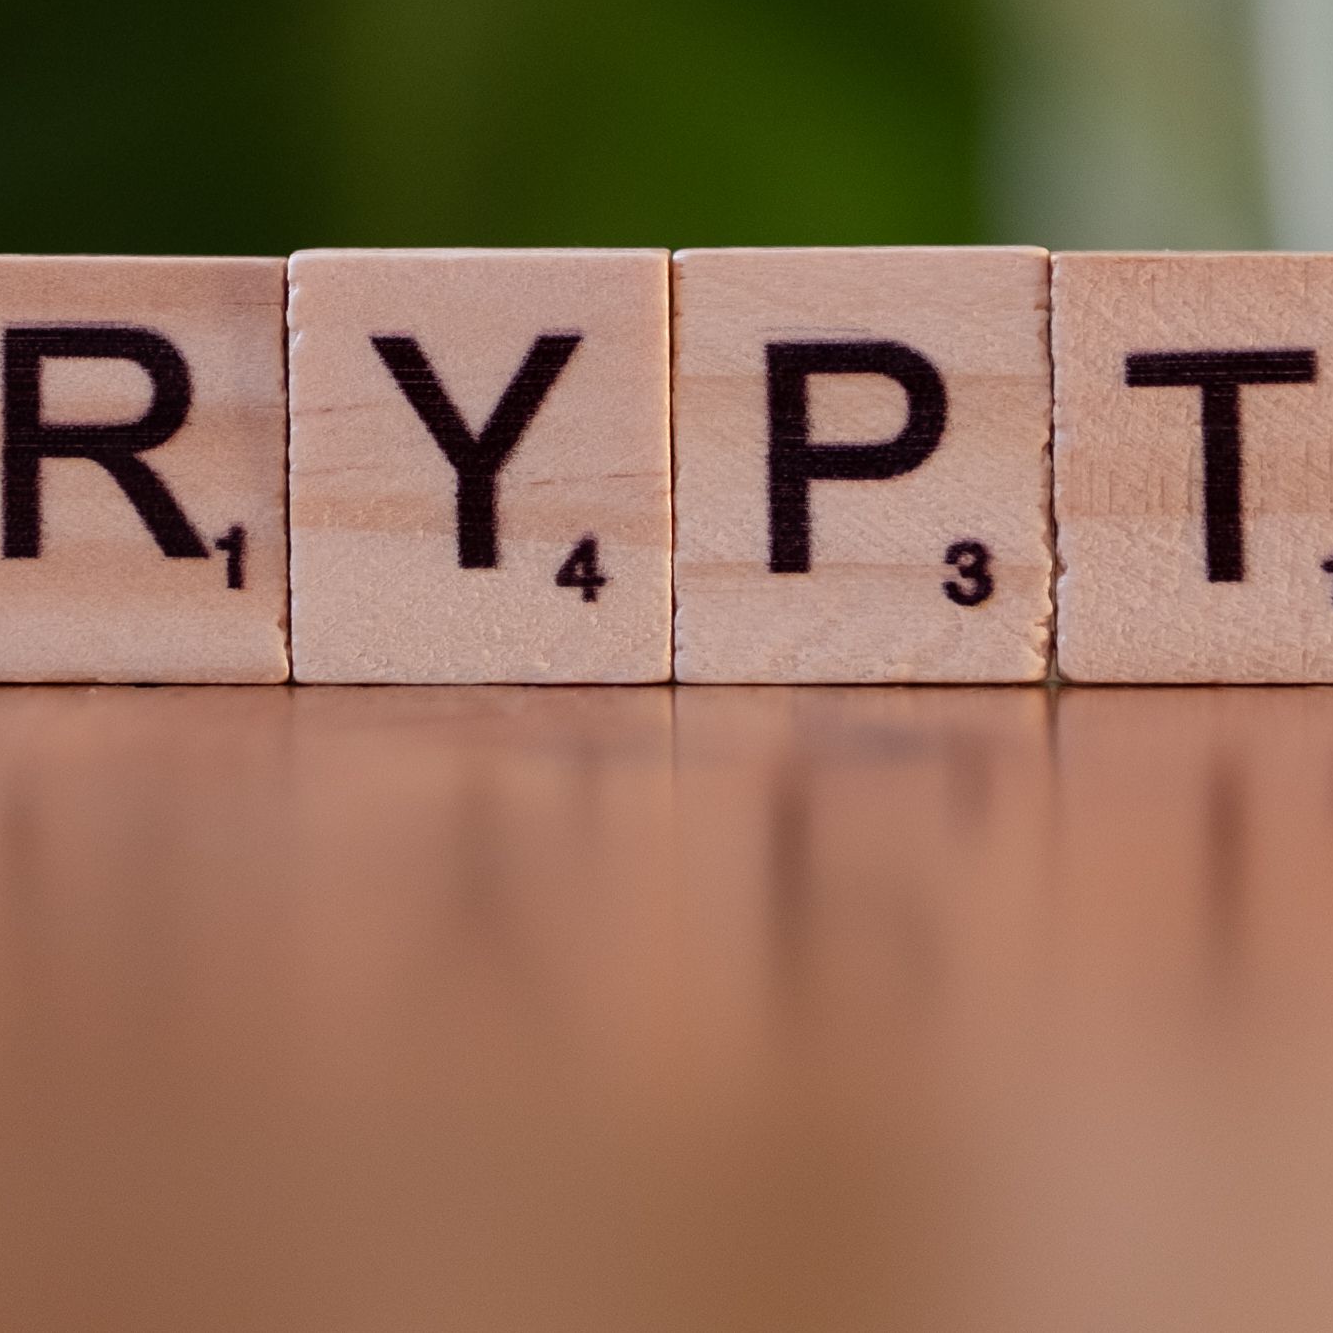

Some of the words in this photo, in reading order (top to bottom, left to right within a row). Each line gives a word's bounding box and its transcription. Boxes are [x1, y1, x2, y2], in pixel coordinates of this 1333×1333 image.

[211, 522, 250, 593] 1
[552, 533, 610, 606] 4
[940, 537, 998, 610] 3
